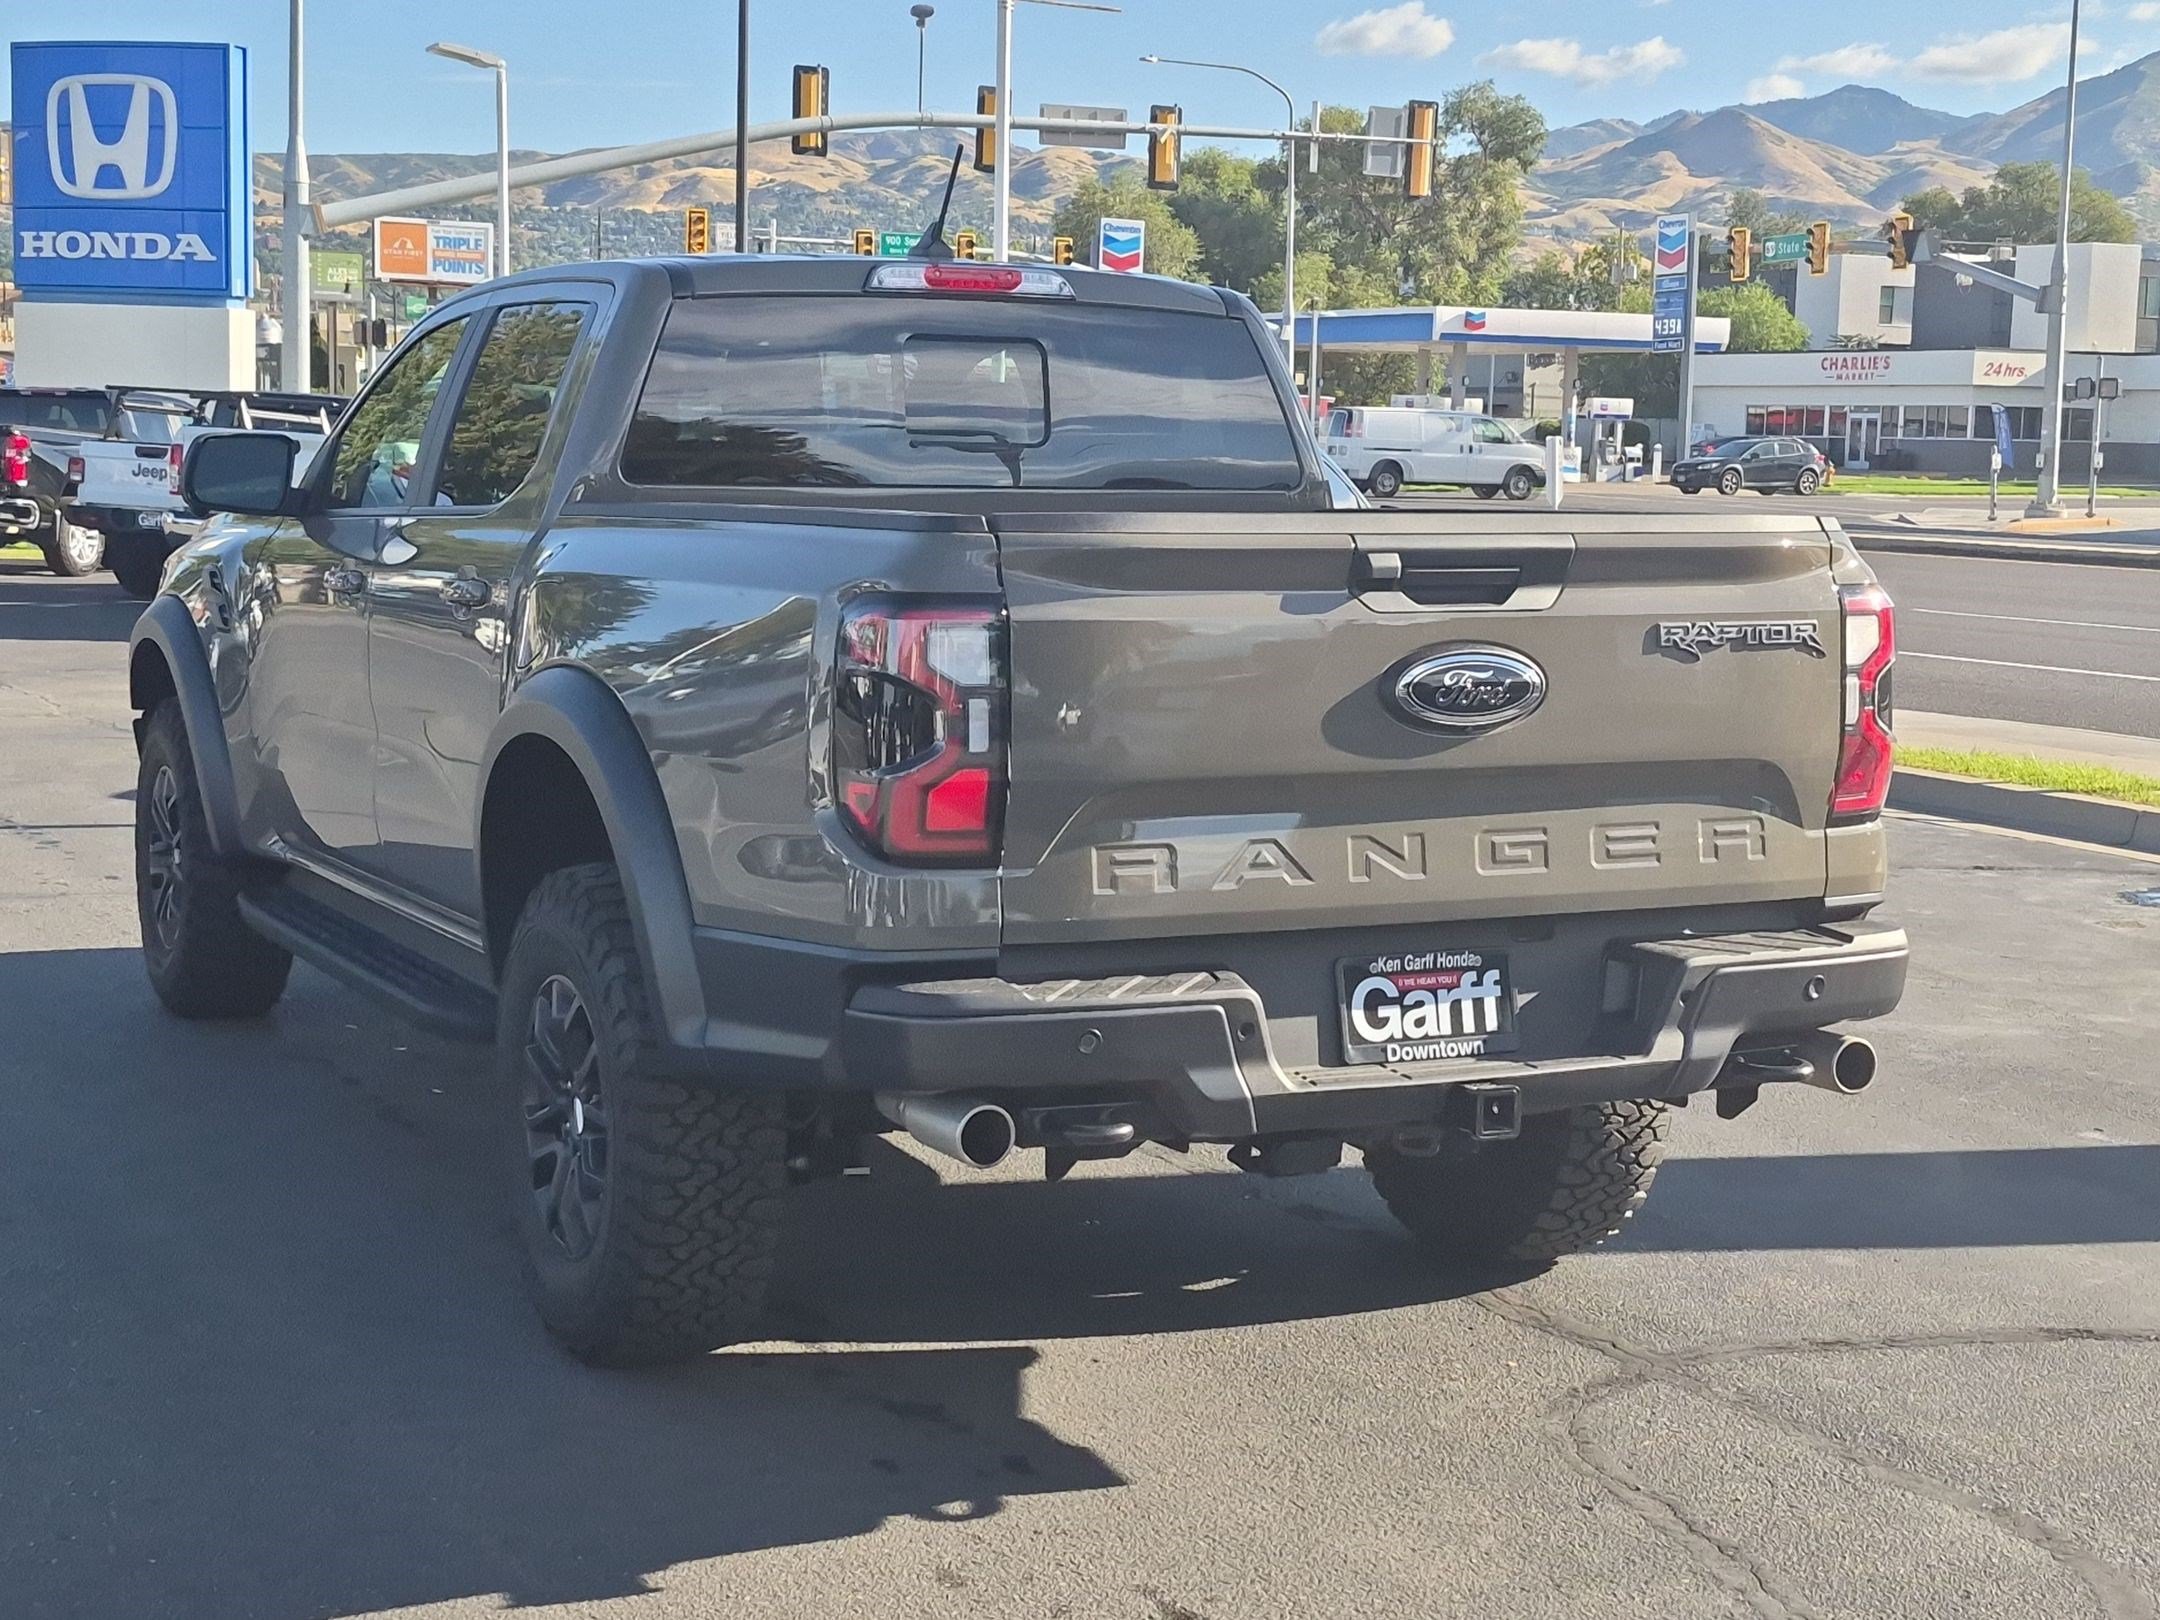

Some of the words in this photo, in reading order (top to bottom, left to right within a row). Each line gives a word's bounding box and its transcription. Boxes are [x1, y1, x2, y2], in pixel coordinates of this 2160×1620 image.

[19, 230, 218, 262] HONDA
[432, 234, 483, 250] TRIPLE
[885, 235, 901, 246] 900
[1778, 241, 1800, 254] State
[432, 259, 485, 275] POINTS
[1821, 355, 1891, 371] CHARLIE'S
[1983, 362, 2003, 377] 24
[2004, 362, 2028, 378] hrs.
[1835, 372, 1875, 381] MARKET
[131, 463, 168, 481] Jeep
[1657, 619, 1827, 661] RAPTOR
[1435, 669, 1513, 707] Ford
[1091, 814, 1767, 896] RANGER
[1377, 955, 1401, 973] Ken
[1404, 952, 1434, 971] Garff
[1437, 950, 1475, 968] Honda
[1403, 977, 1415, 986] WE
[1416, 976, 1437, 985] HEAR
[1438, 976, 1452, 985] YOU
[1351, 968, 1502, 1043] Garff
[1386, 1040, 1485, 1063] Downtown
